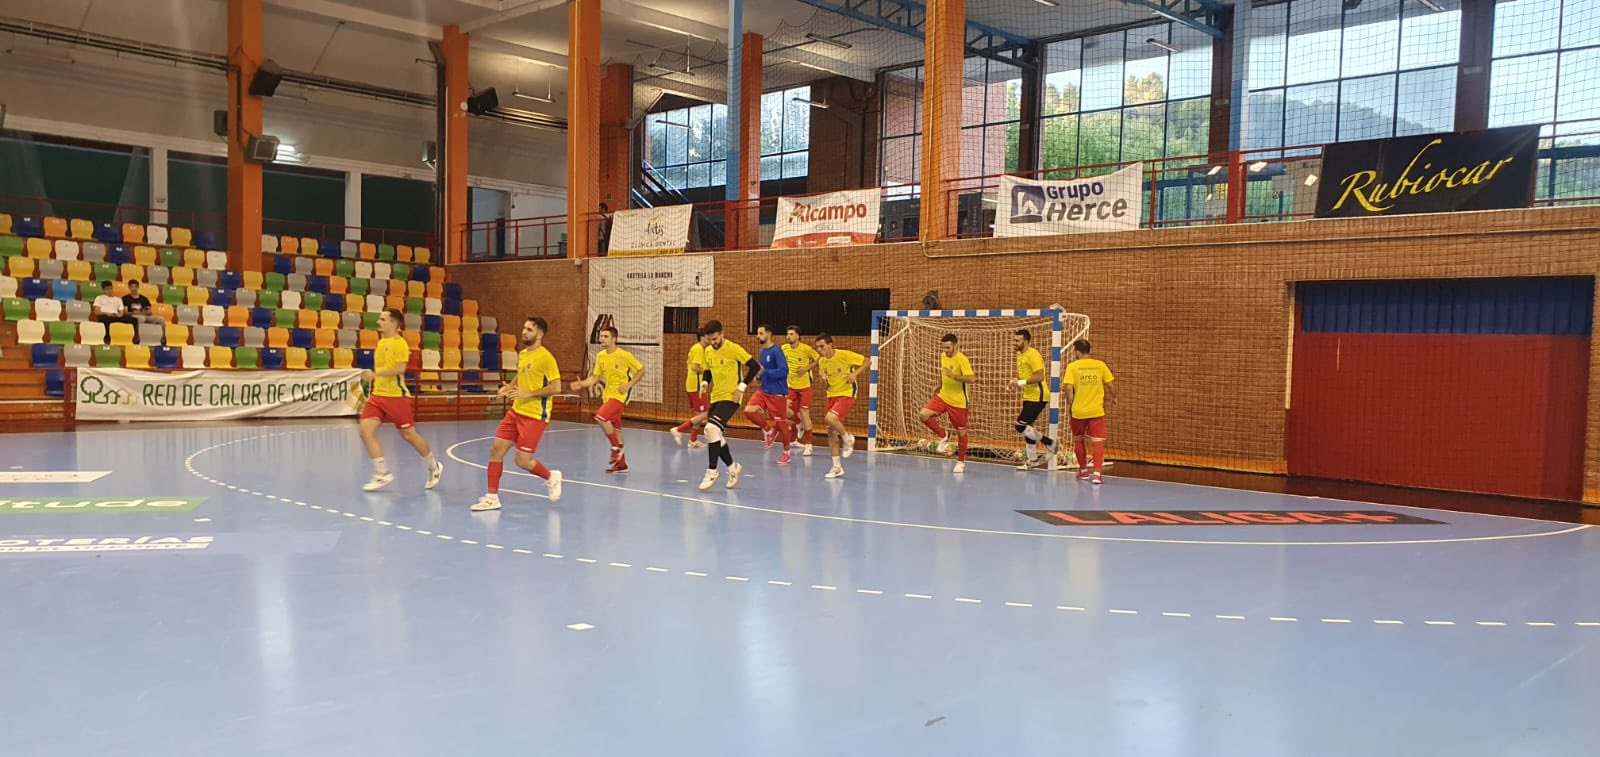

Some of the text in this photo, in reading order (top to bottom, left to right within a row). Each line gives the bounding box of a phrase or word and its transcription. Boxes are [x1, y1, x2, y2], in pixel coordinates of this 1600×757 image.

[1332, 138, 1514, 212] Rubiocar
[1046, 181, 1104, 201] Grupo
[788, 202, 867, 223] Alcampo
[1046, 198, 1128, 222] Herce
[142, 381, 348, 406] RED DE CALOR DE CUENCA
